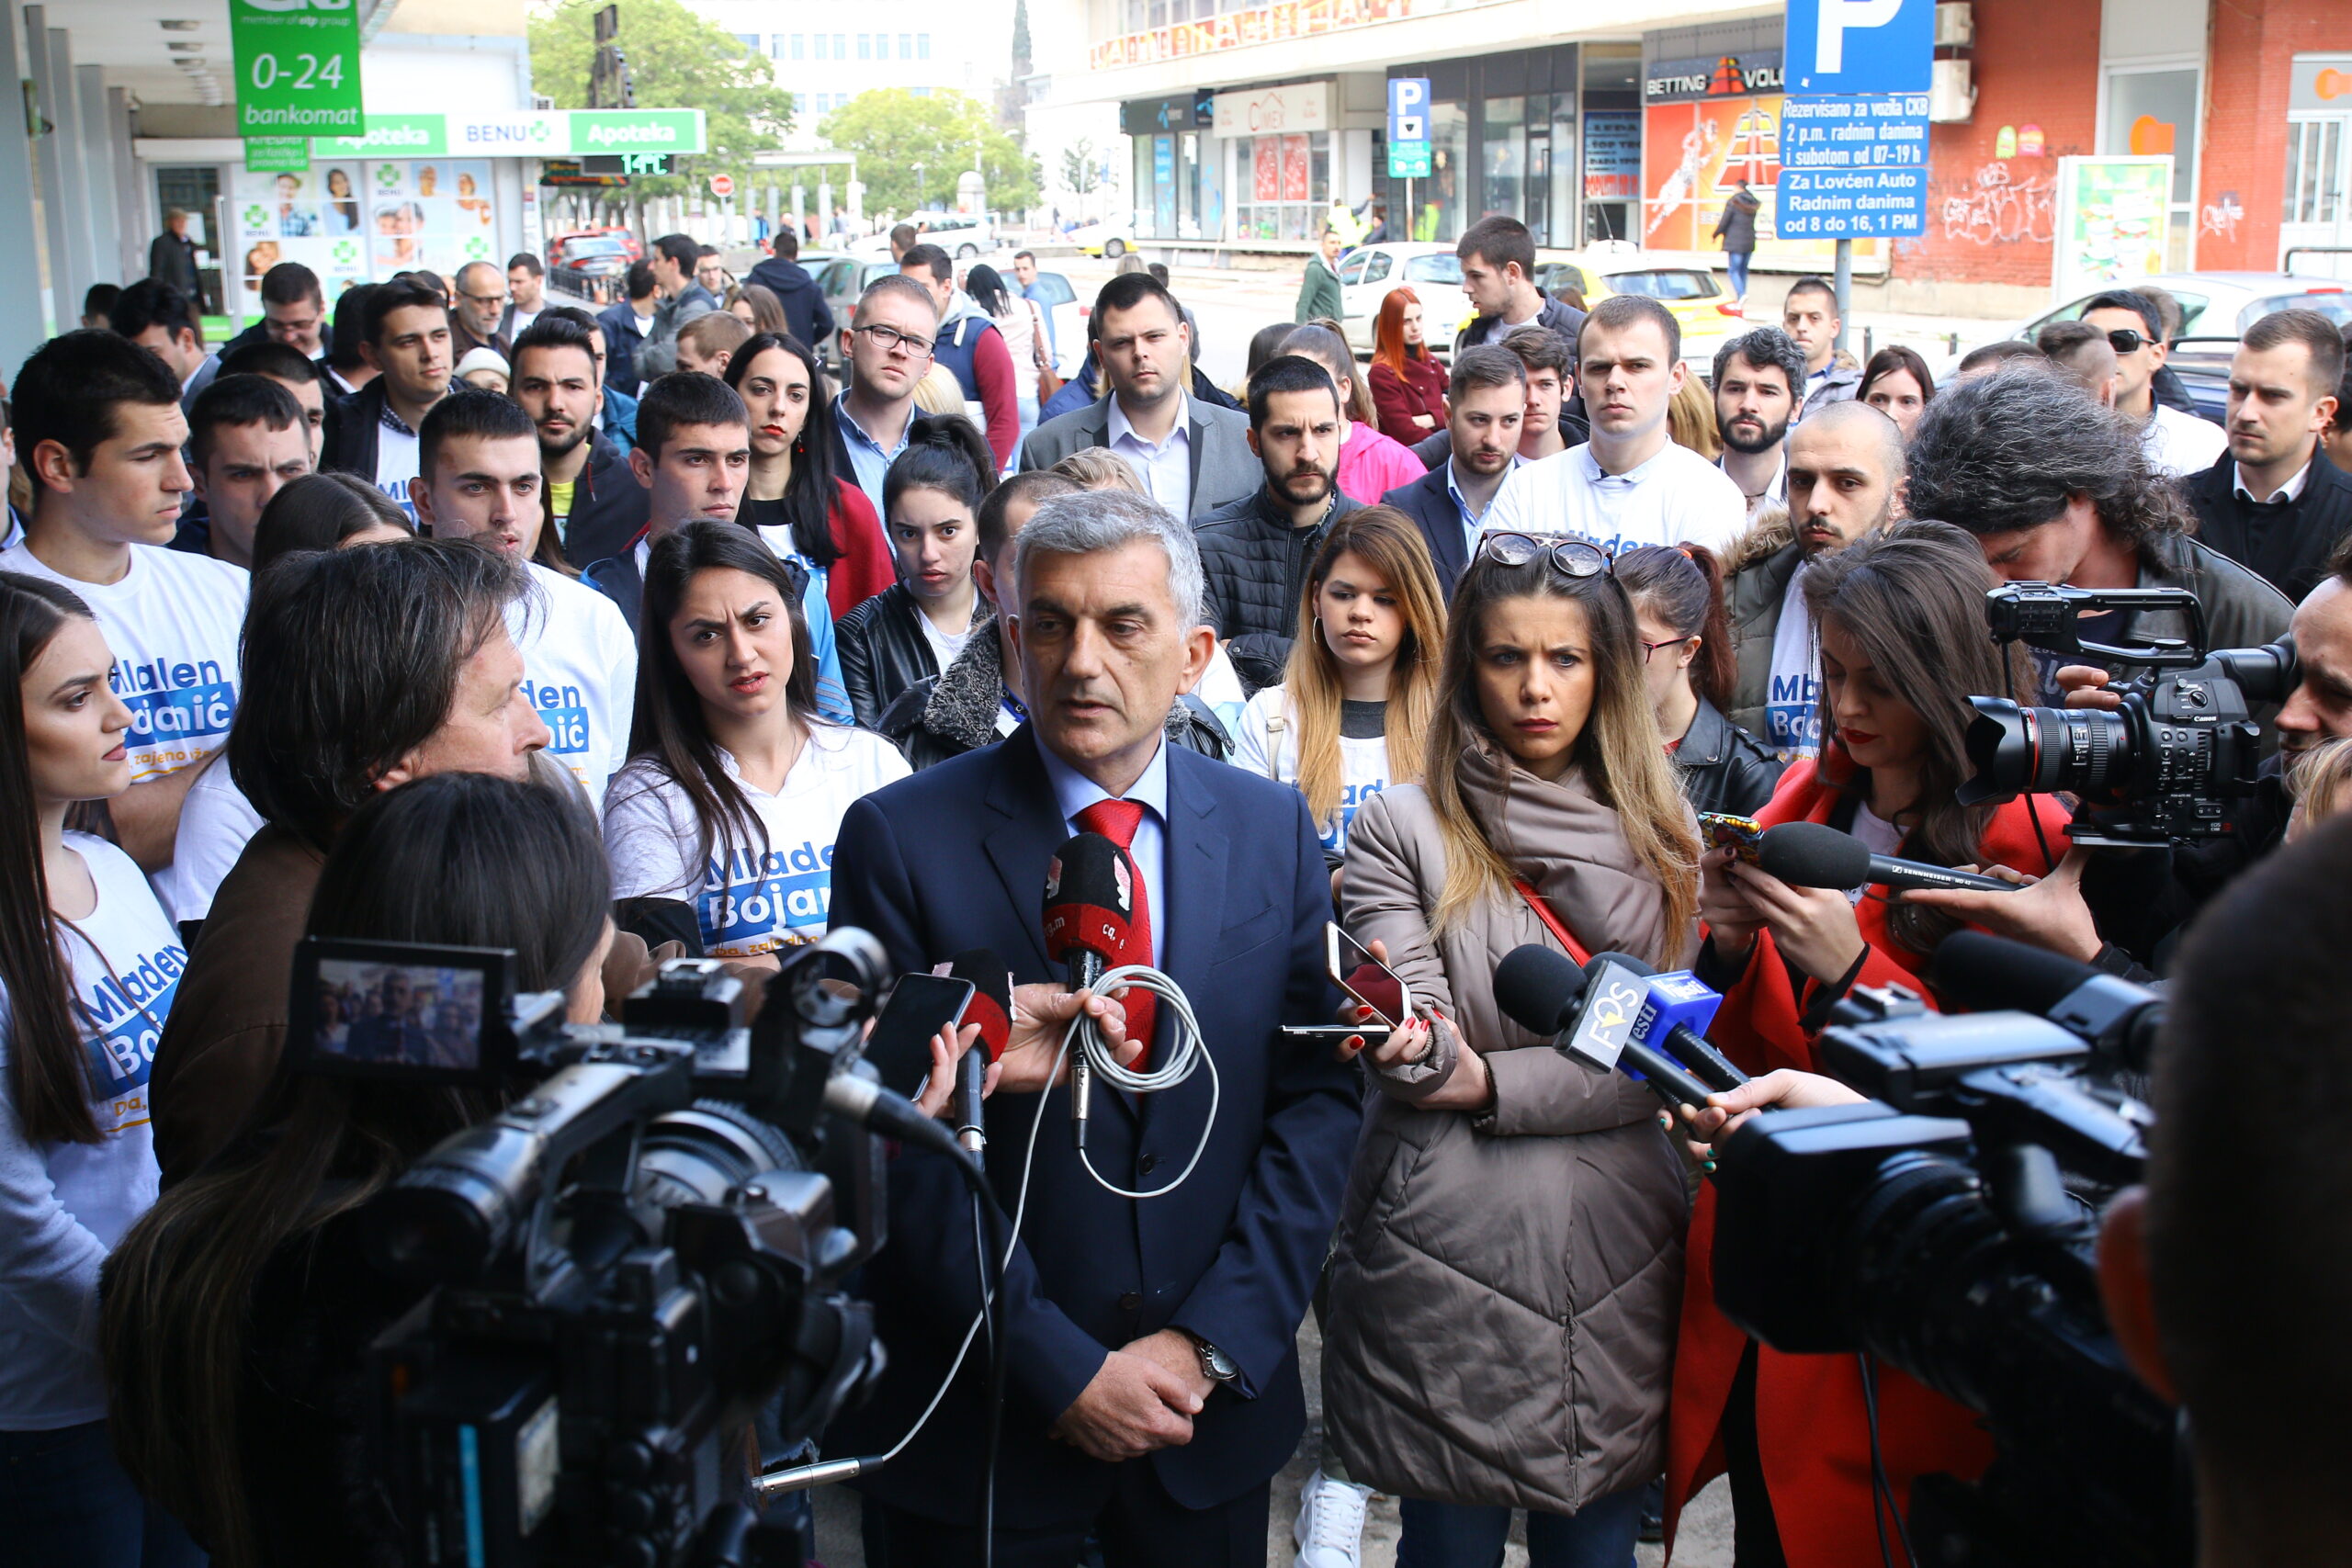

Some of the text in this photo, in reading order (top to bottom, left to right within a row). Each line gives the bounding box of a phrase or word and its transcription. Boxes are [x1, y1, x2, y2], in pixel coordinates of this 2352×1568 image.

[242, 15, 285, 24] member
[287, 14, 299, 24] of
[321, 17, 350, 28] group
[1815, 0, 1904, 73] P
[252, 53, 344, 89] 0-24
[1646, 74, 1707, 96] BETTING
[1397, 82, 1422, 116] P
[1782, 97, 1928, 118] Rezervisano za vozila CKB
[244, 104, 358, 125] bankomat
[467, 125, 526, 141] BENU
[588, 121, 676, 146] Apoteka
[1786, 121, 1923, 146] 2 p.m. radnim danima
[1786, 147, 1791, 165] i
[1795, 147, 1849, 166] subotom
[1853, 145, 1870, 164] od
[1912, 147, 1921, 164] h
[1789, 175, 1810, 190] Za
[1877, 173, 1917, 188] Auto
[1789, 194, 1915, 211] Radnim danima
[1784, 217, 1806, 232] od
[1810, 217, 1821, 231] 8
[1825, 216, 1846, 231] do
[1850, 216, 1873, 232] 16,
[1878, 215, 1886, 230] 1
[1891, 214, 1917, 230] PM
[129, 691, 230, 735] ojanić
[1904, 868, 1951, 882] SENNHEISER
[1589, 982, 1639, 1050] FOS
